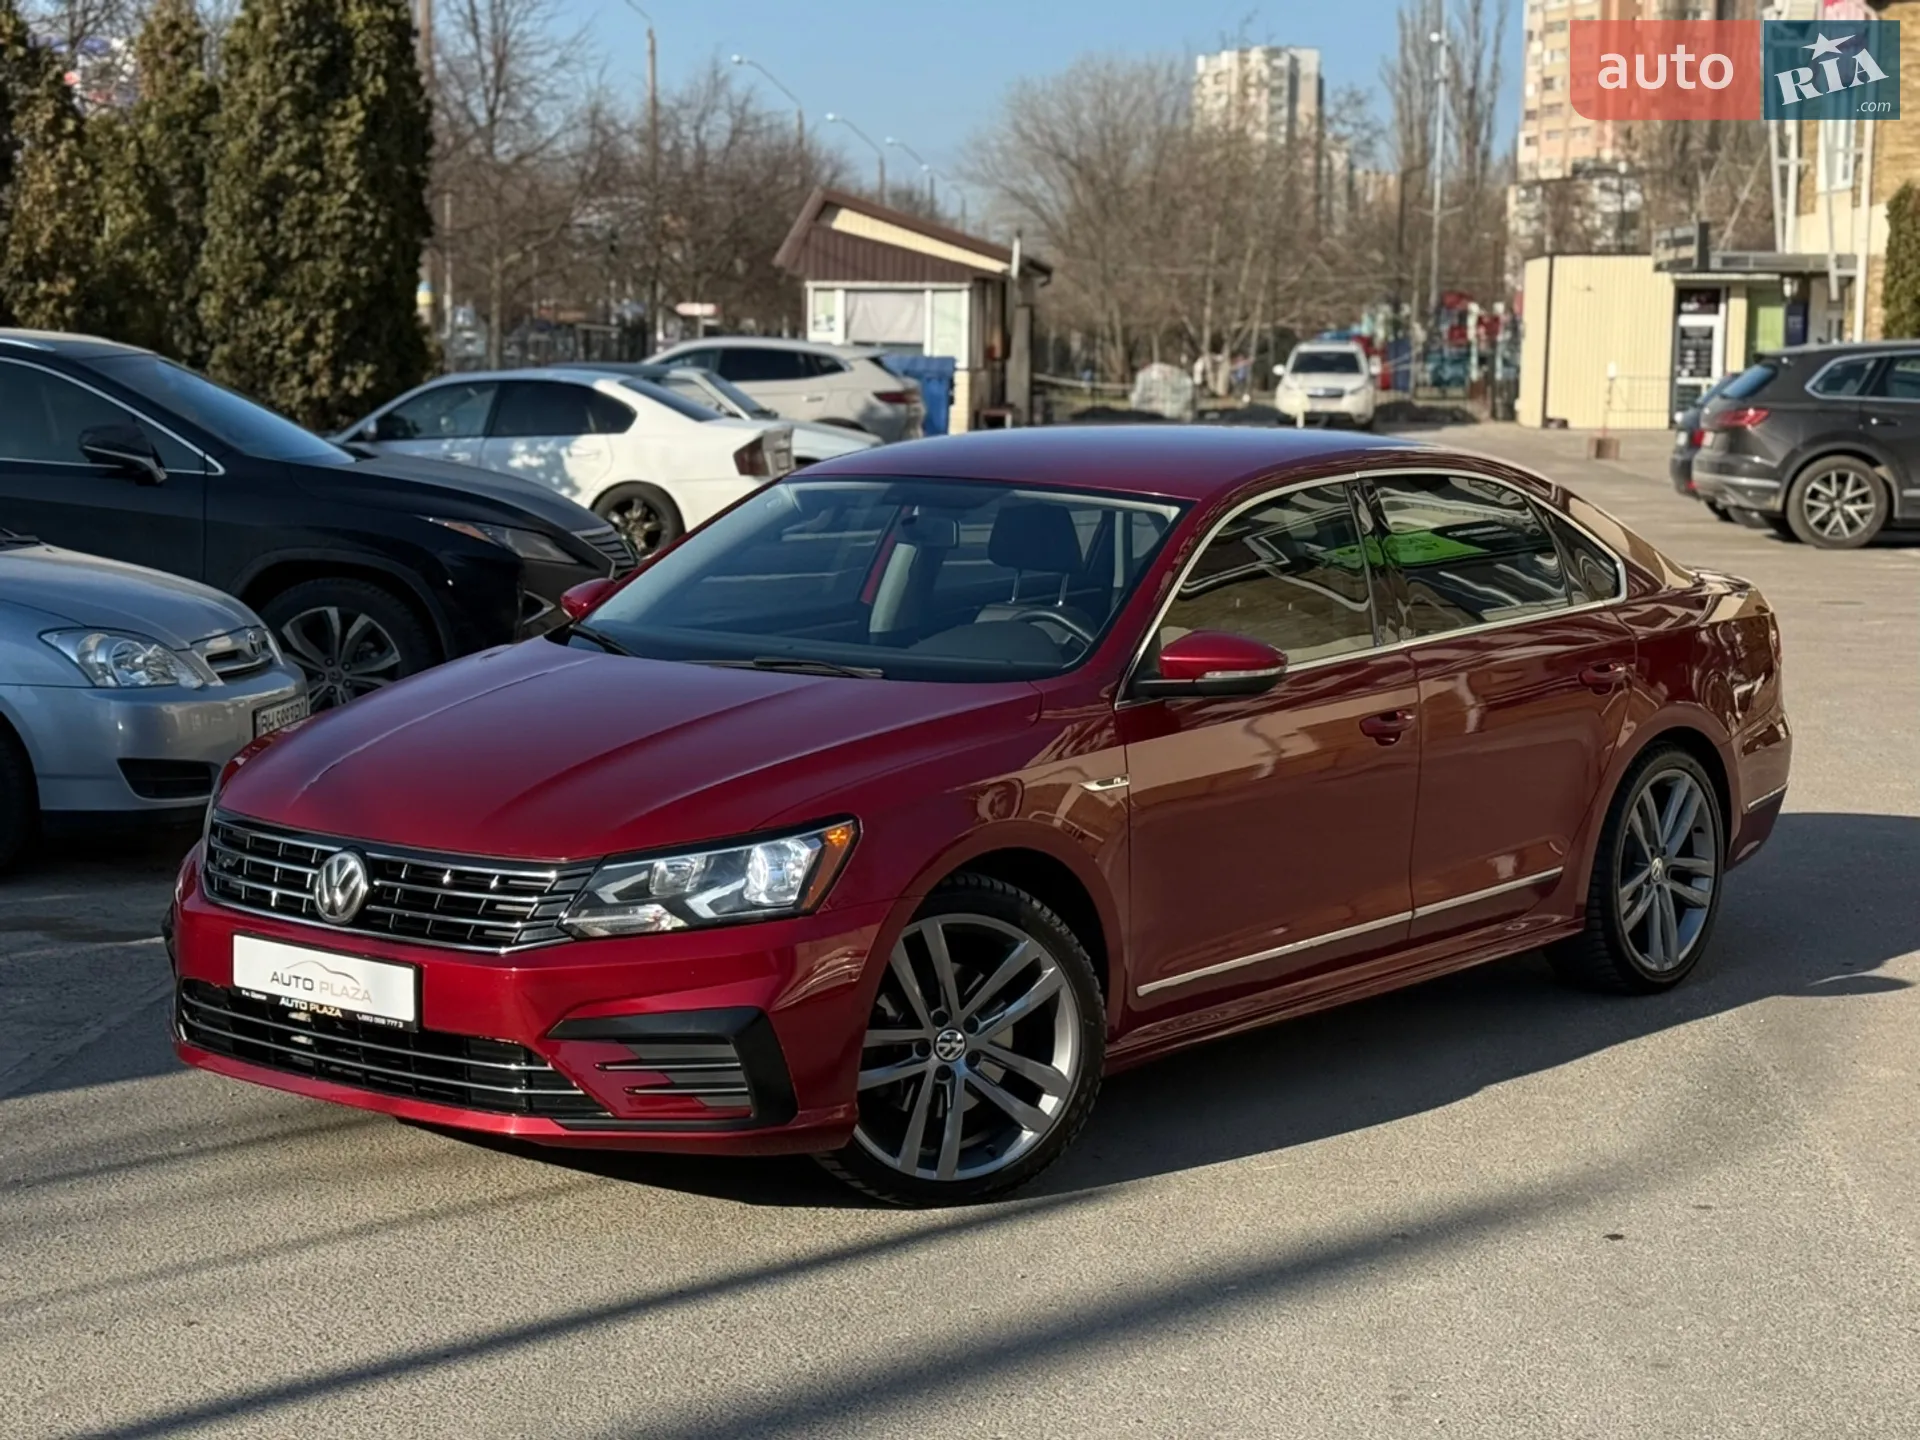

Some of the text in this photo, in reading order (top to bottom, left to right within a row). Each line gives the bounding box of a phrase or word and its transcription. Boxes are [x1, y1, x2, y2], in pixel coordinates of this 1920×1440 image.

[270, 971, 373, 1004] AUTO PLAZA
[279, 996, 343, 1018] AUTO PLAZA
